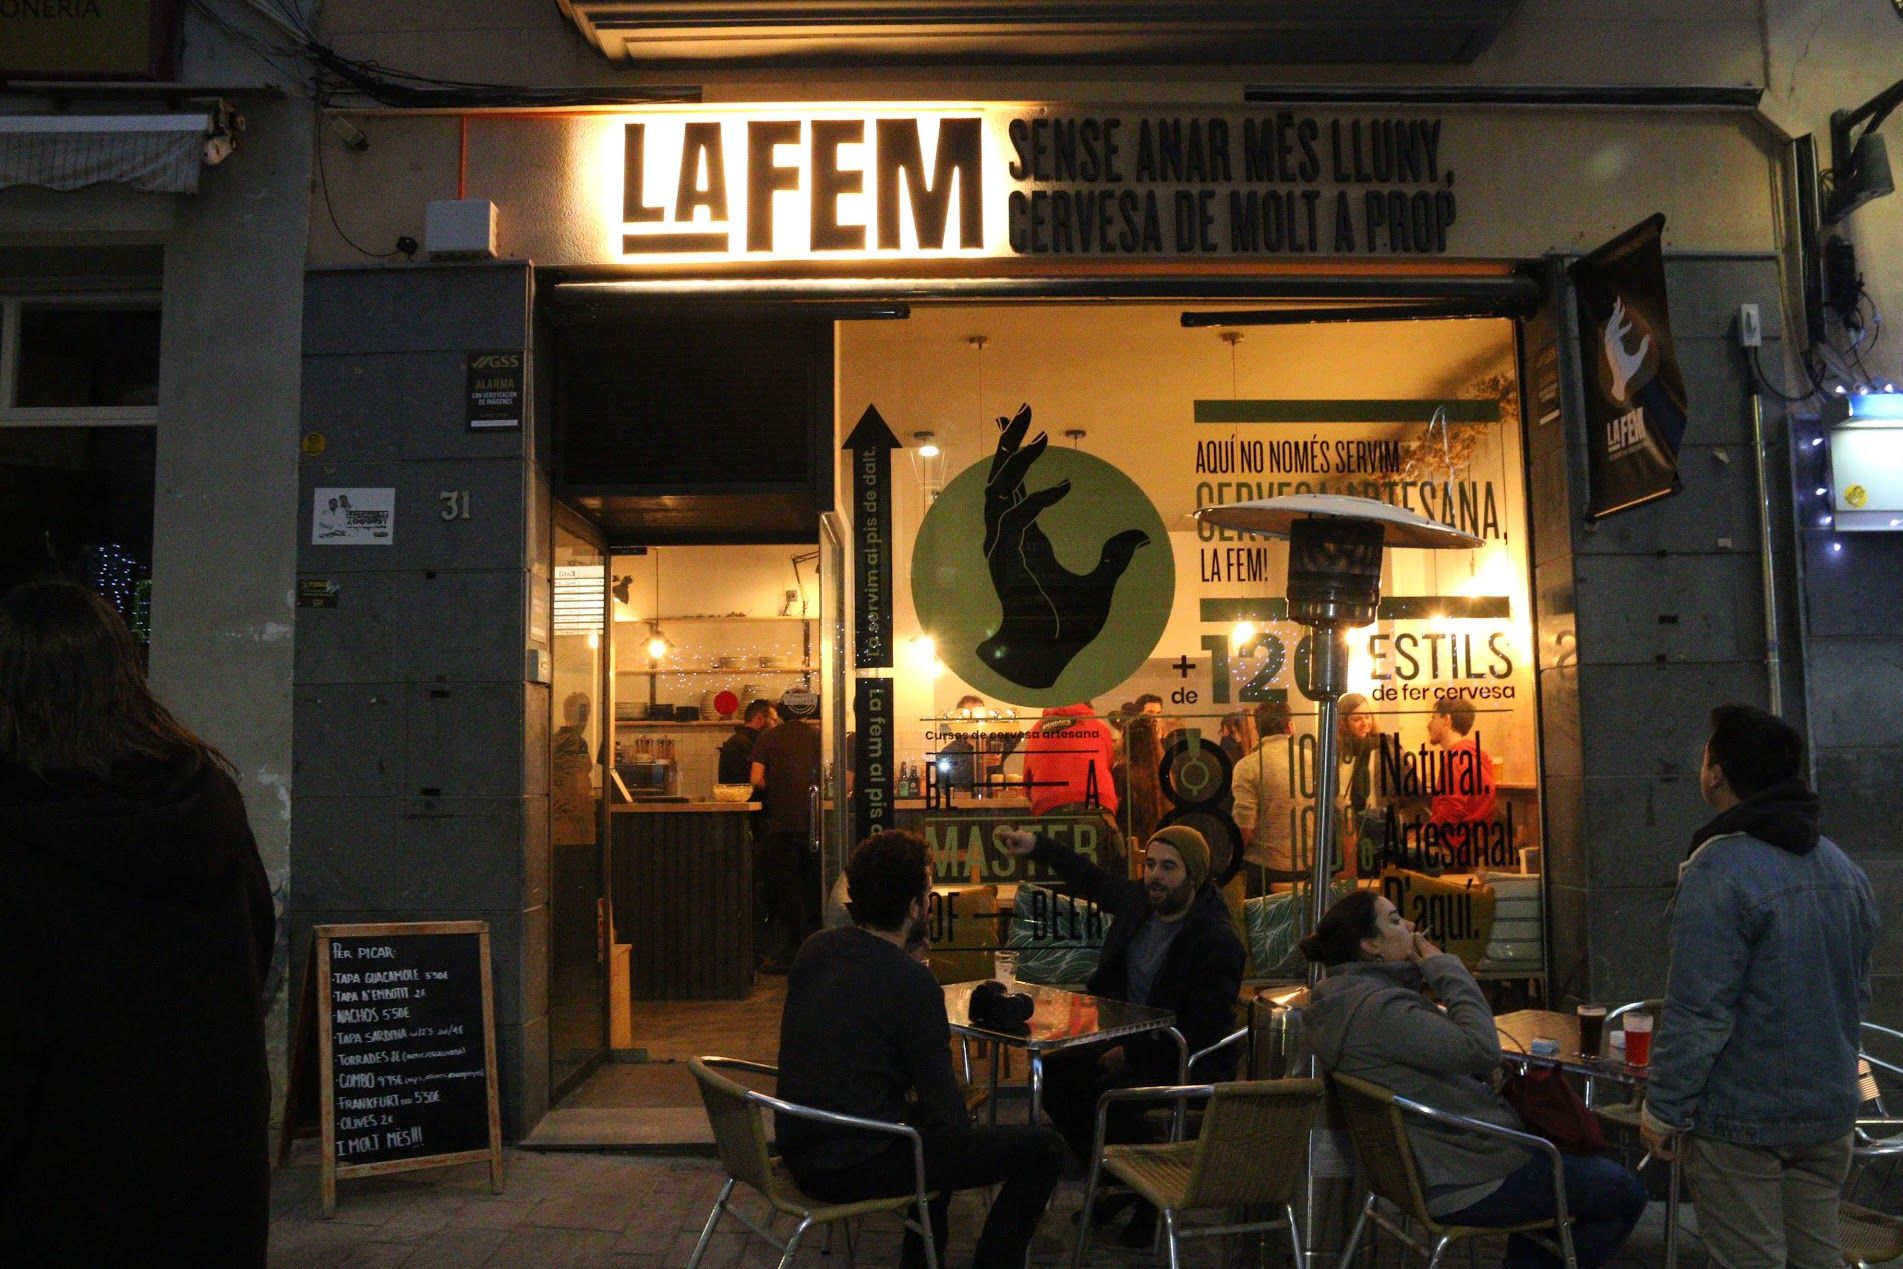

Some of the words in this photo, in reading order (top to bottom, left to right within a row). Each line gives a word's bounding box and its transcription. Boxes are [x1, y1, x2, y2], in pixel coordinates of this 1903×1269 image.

[1008, 117, 1122, 183] SENSE
[1136, 117, 1232, 183] ANAR
[1244, 109, 1320, 183] MÉS
[1331, 117, 1456, 189] LLUNY,
[1008, 189, 1163, 254] CERVESA
[1175, 189, 1218, 253] DE
[1230, 189, 1320, 253] MOLT
[1334, 189, 1355, 253] A
[1365, 189, 1457, 253] PROP
[488, 355, 520, 368] GSS
[474, 377, 515, 389] ALARMA
[862, 445, 878, 486] dalt.
[1195, 433, 1236, 474] AQUÍ
[1240, 440, 1264, 474] NO
[1270, 433, 1331, 474] NOMÉS
[1335, 439, 1400, 473] SERVIM
[439, 490, 472, 521] 31
[862, 490, 878, 512] de
[863, 517, 882, 544] pis
[862, 548, 878, 565] al
[1201, 548, 1221, 583] LA
[1226, 546, 1269, 583] FEM!
[864, 570, 880, 633] servim
[1368, 631, 1514, 681] ESTILS
[868, 689, 885, 711] La
[1171, 686, 1199, 705] de
[1372, 684, 1398, 701] de
[1401, 683, 1430, 701] fer
[1433, 685, 1516, 701] cervesa
[868, 716, 887, 757] fem
[925, 730, 969, 740] Cursos
[971, 730, 987, 739] de
[988, 730, 1040, 739] cervesa
[1042, 729, 1100, 739] artesana
[869, 763, 887, 782] al
[1378, 730, 1491, 798] Natural.
[1085, 759, 1101, 810] A
[864, 787, 888, 818] pis
[1382, 800, 1520, 869] Artesanal.
[364, 968, 421, 984] GUACAMOLE
[365, 1028, 408, 1043] SARDINA
[336, 1140, 347, 1157] I
[348, 1134, 381, 1154] MOLT
